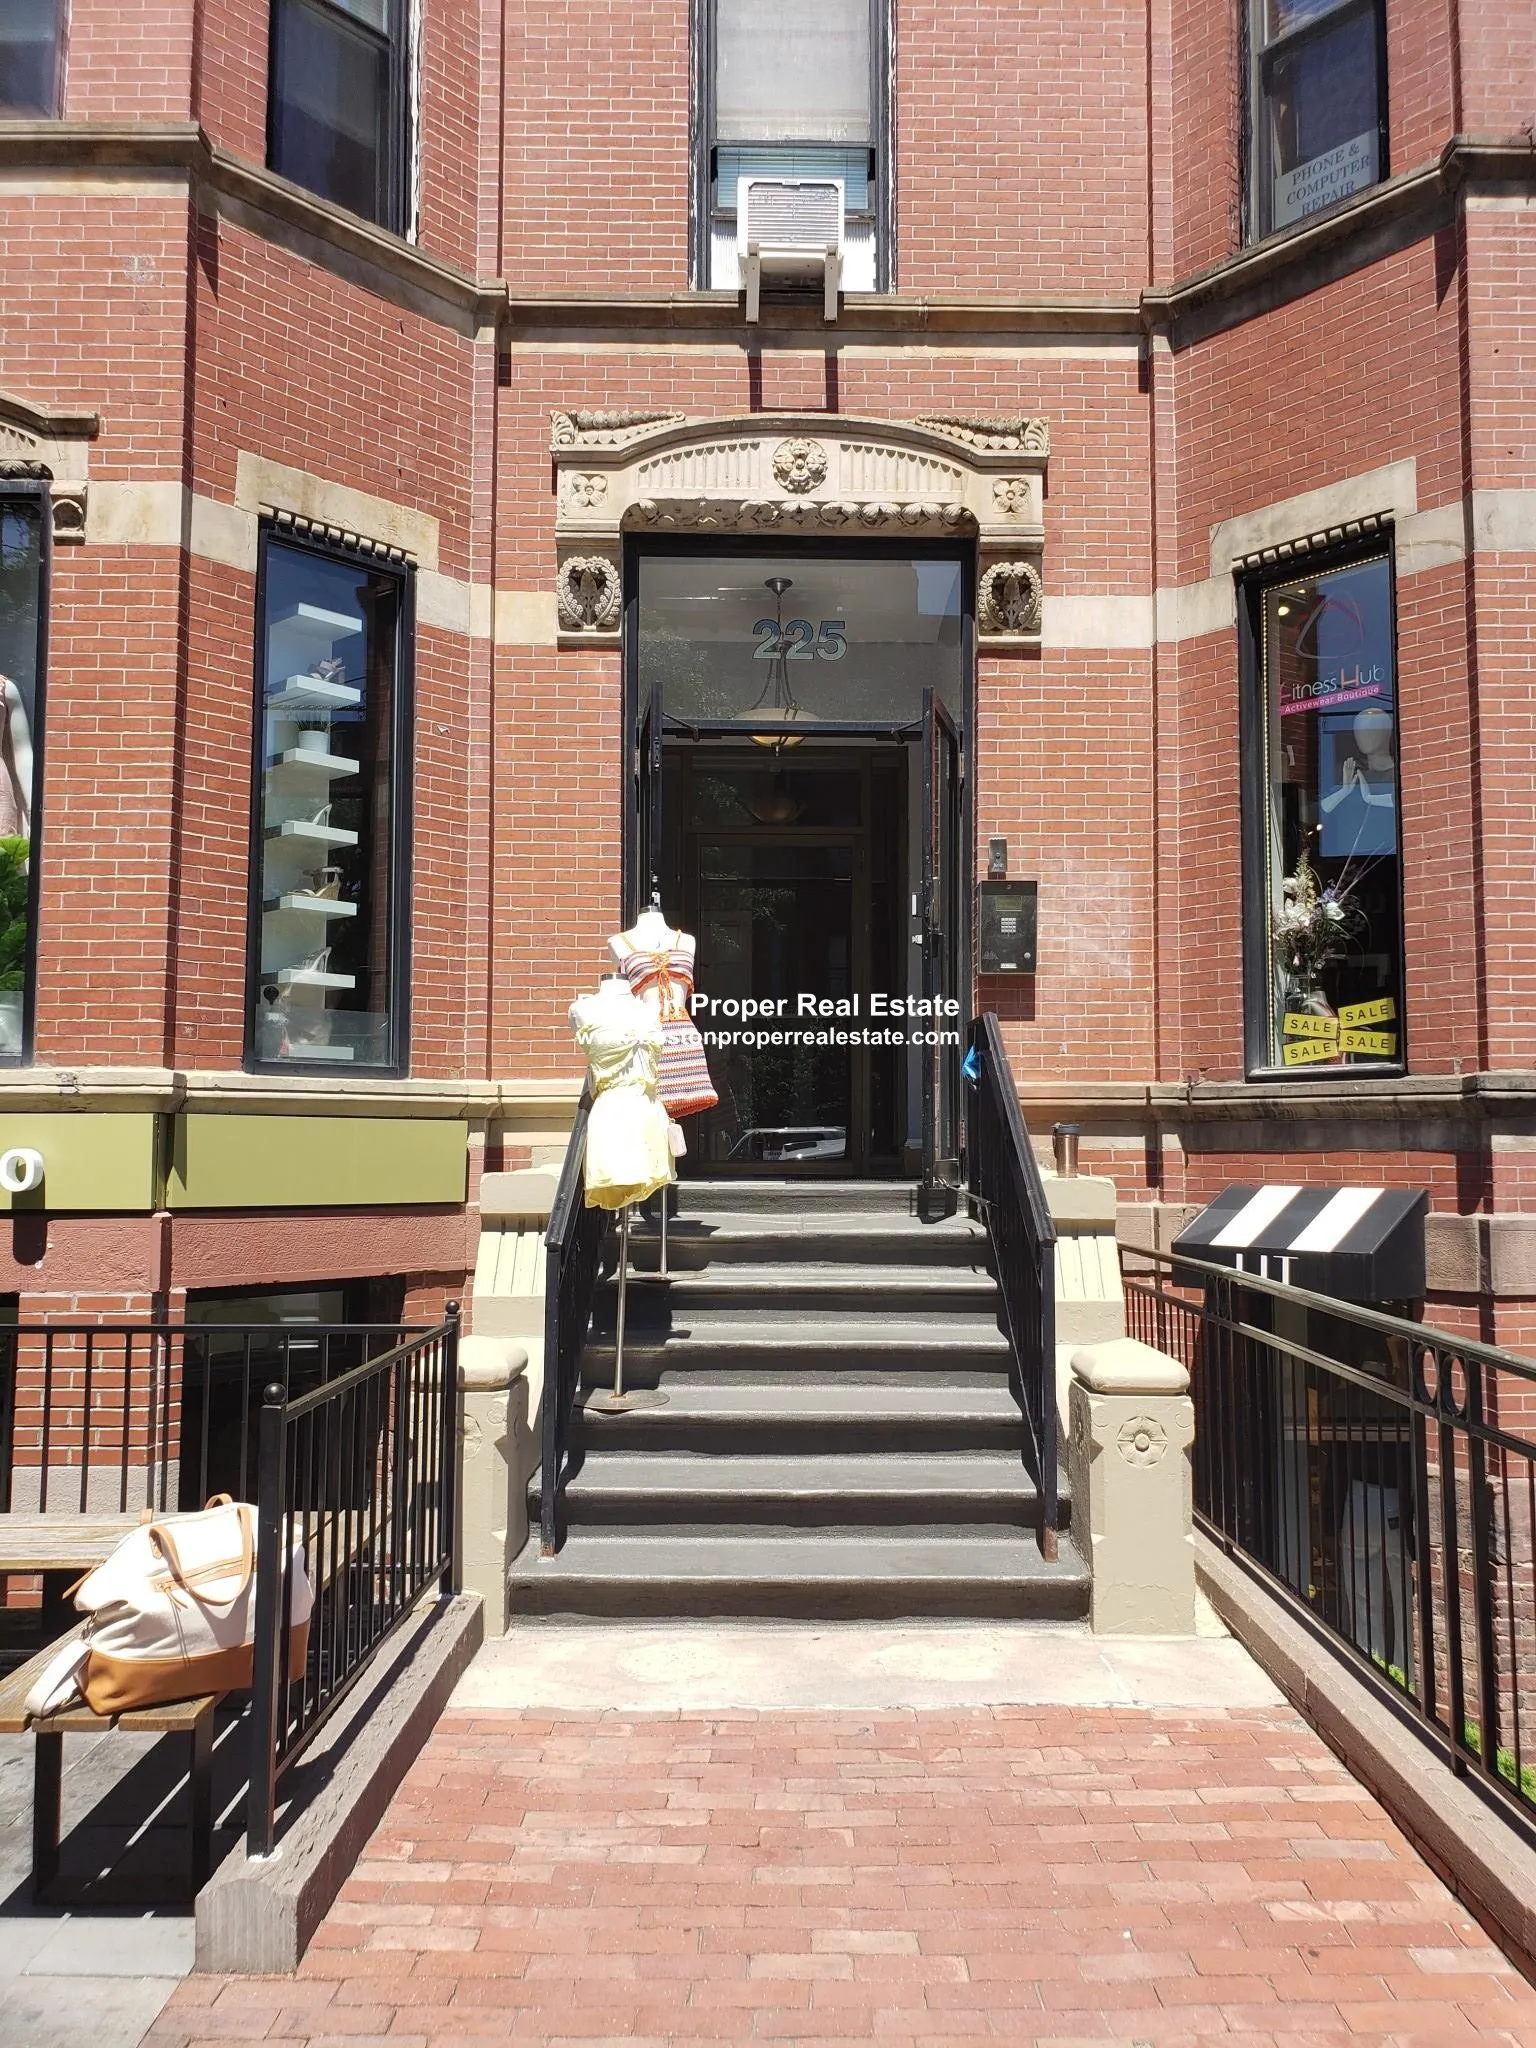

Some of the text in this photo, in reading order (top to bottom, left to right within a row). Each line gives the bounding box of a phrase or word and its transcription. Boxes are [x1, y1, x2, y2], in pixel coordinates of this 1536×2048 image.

[1292, 143, 1360, 186] PHONE &
[1286, 155, 1369, 205] COMPUTER
[1301, 180, 1355, 216] REPAIR
[752, 618, 848, 661] 225
[1340, 664, 1385, 690] Hub
[1284, 687, 1380, 714] Activewear Boutique
[1290, 1019, 1331, 1033] SALE
[1345, 1004, 1389, 1022] SALE
[1290, 1042, 1331, 1059] SALE
[1346, 1035, 1390, 1049] SALE
